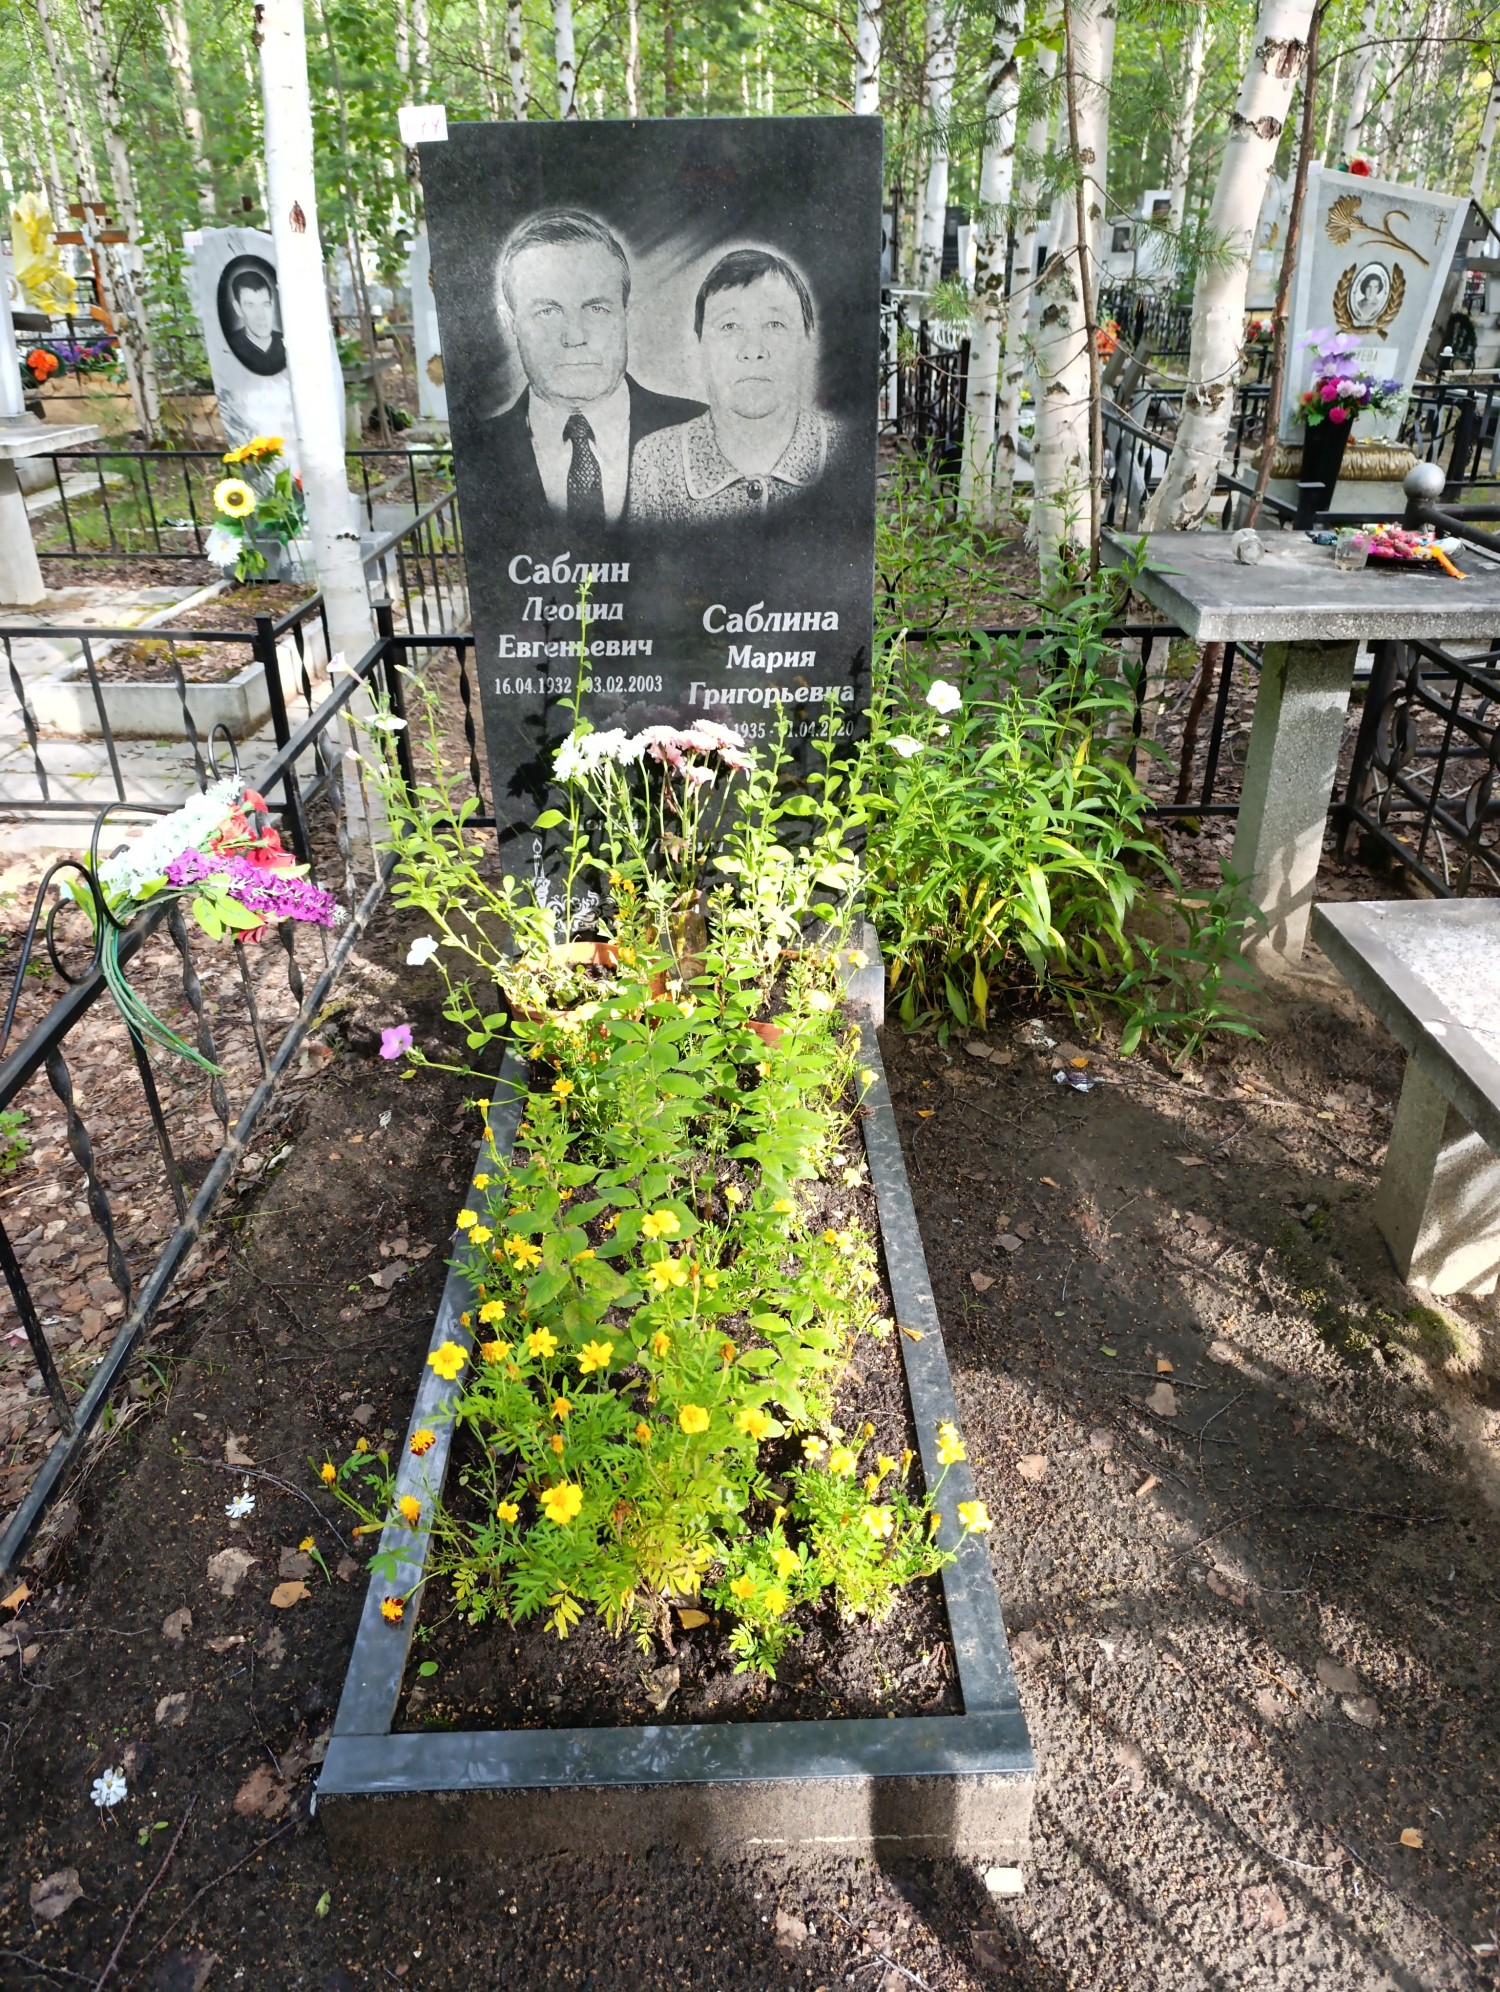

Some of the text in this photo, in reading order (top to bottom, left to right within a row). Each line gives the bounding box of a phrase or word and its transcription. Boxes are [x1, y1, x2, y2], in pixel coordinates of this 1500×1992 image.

[508, 551, 630, 585] Саблин
[521, 596, 624, 622] Леонид
[702, 600, 839, 634] Саблина
[498, 634, 653, 658] Евгеньевич
[725, 645, 817, 673] Мария
[494, 676, 572, 695] 16.04.1932
